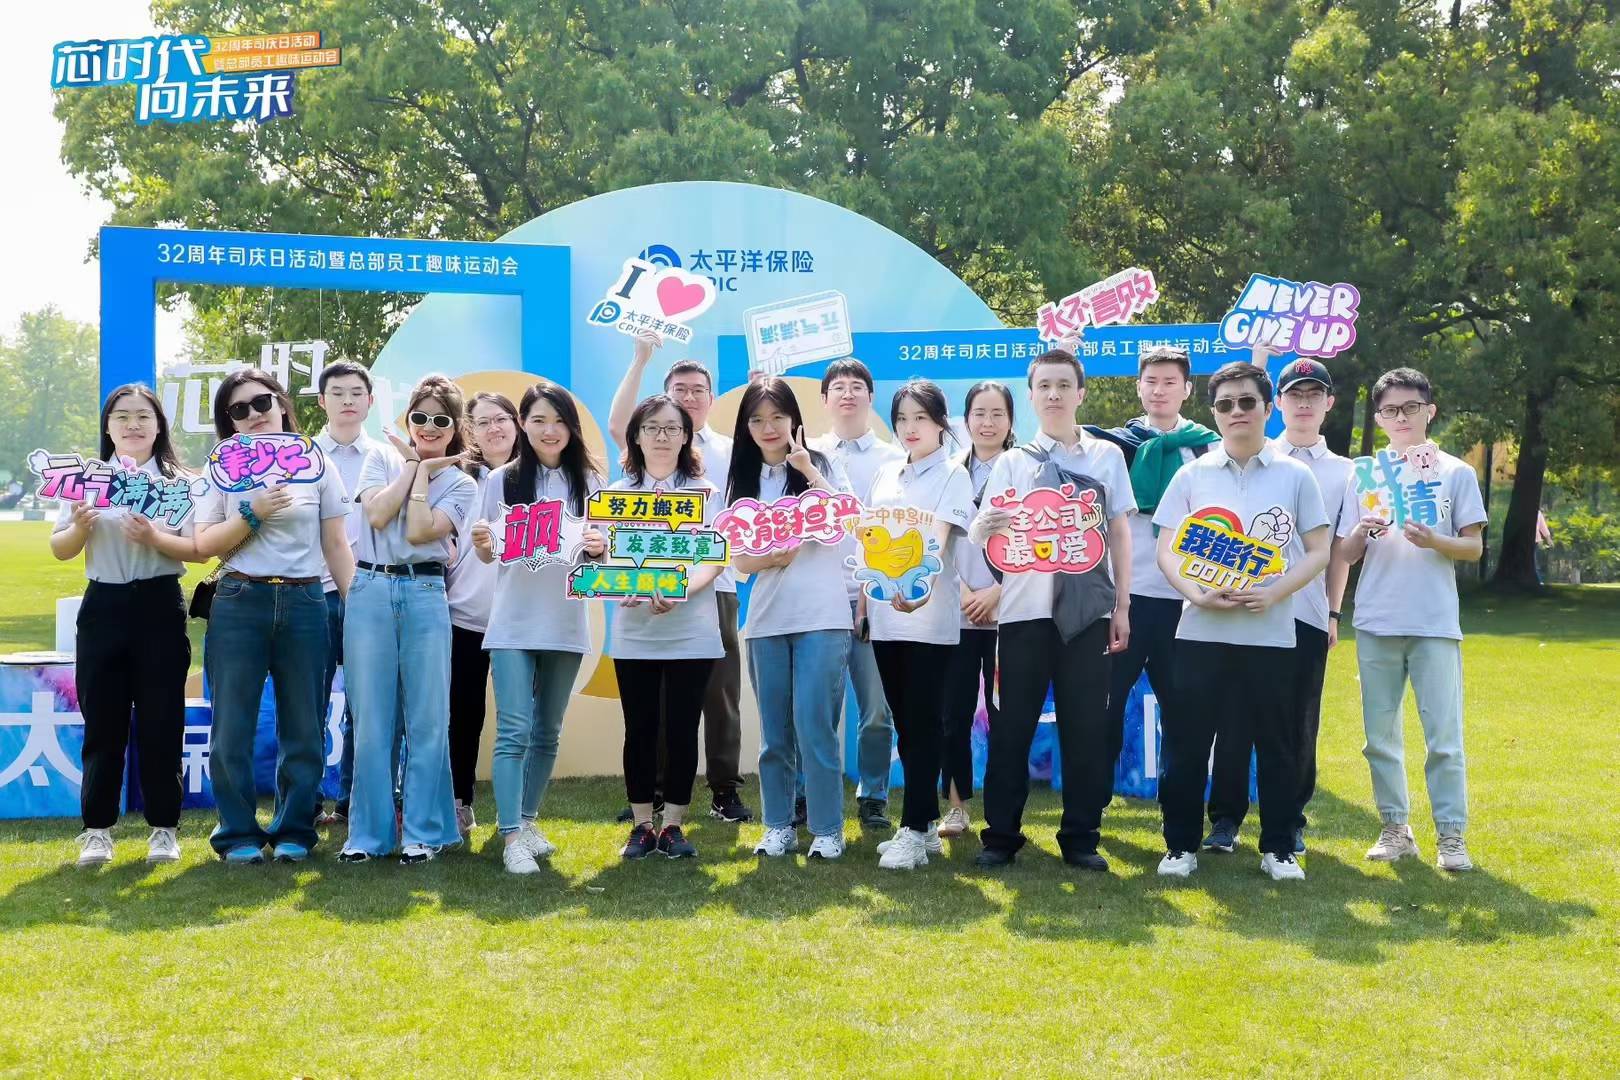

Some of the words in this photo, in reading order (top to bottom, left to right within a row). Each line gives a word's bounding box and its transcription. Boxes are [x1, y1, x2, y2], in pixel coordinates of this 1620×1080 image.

[157, 243, 519, 276] 32周年司庆日活动暨总部员工趣味运动会
[689, 250, 814, 273] 太平洋保险
[615, 265, 647, 299] I
[1040, 273, 1154, 338] 永不言败
[1239, 278, 1354, 320] NEVER
[622, 309, 691, 341] 太平洋保险
[1224, 312, 1296, 347] GIVE
[1300, 319, 1351, 353] UP
[899, 337, 1227, 361] 32周年司庆日活动部员工趣味运动会
[218, 441, 311, 482] 美少女
[40, 455, 193, 527] 元气满满
[608, 496, 695, 518] 努力搬砖
[1009, 503, 1083, 532] 全公司
[626, 533, 713, 556] 发家致富
[1002, 530, 1090, 567] 最可爱
[1178, 522, 1275, 578] 我能行
[591, 571, 678, 592] 人生巅峰
